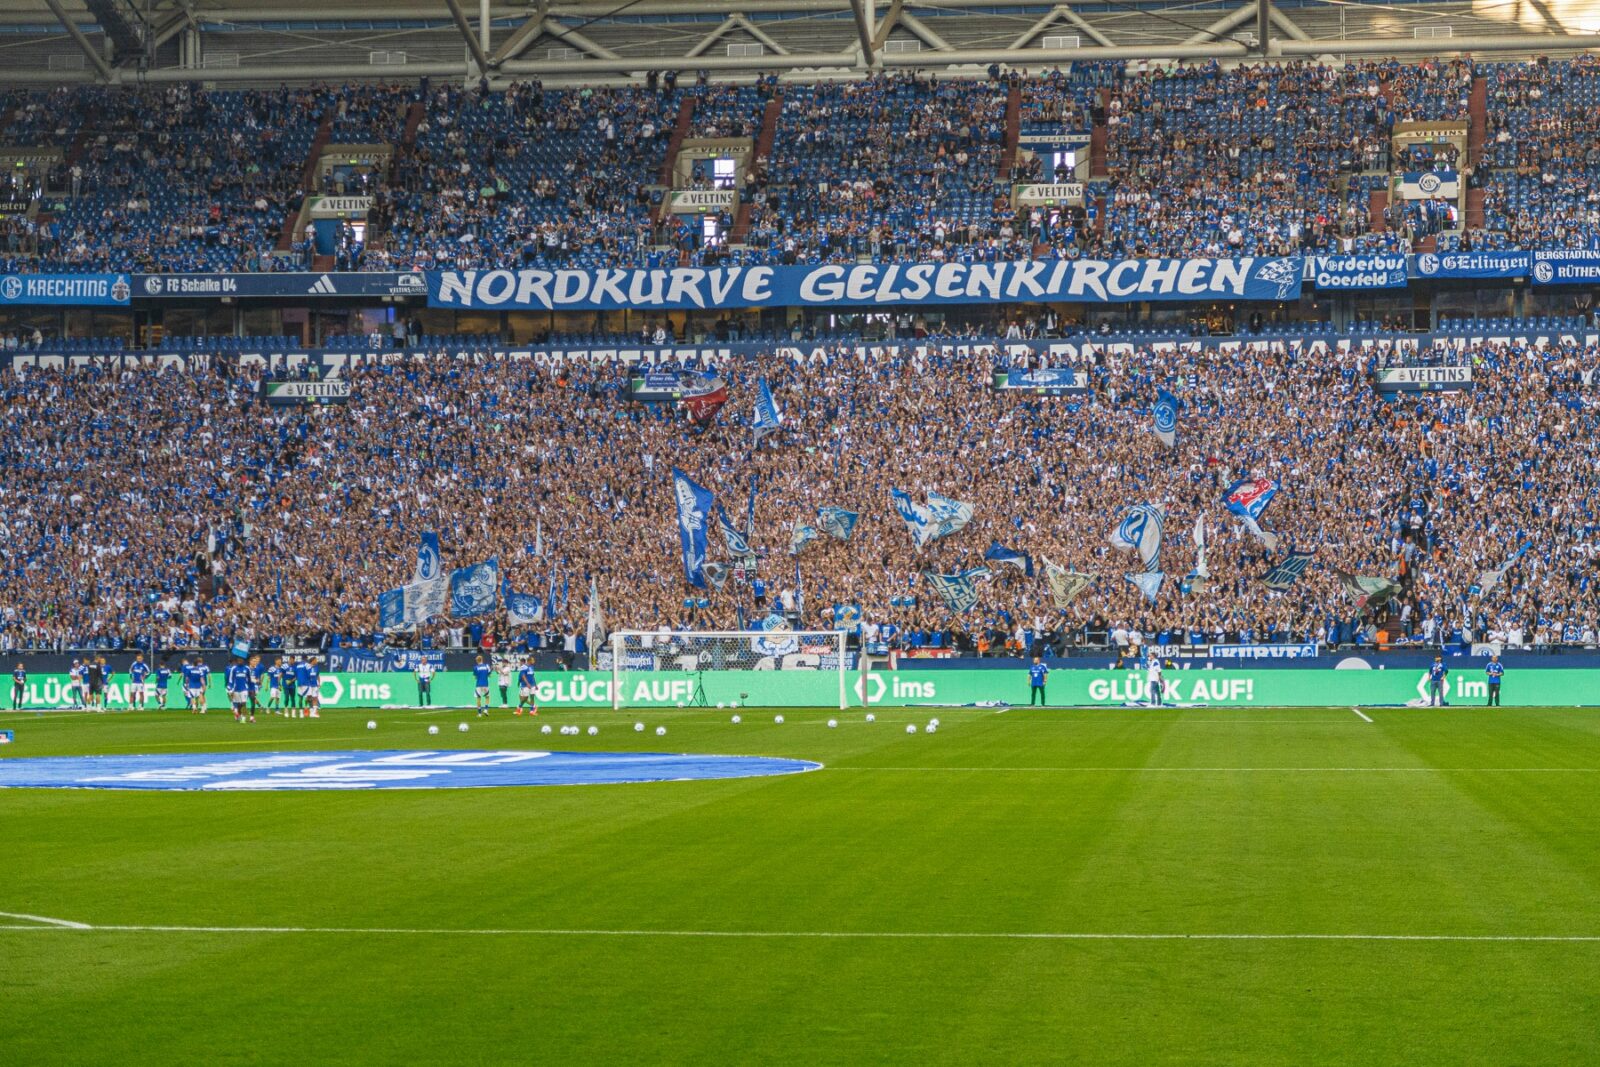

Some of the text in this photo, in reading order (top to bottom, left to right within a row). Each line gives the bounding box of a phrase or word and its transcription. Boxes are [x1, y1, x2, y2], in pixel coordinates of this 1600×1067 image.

[690, 193, 734, 203] VELTINS
[1037, 186, 1082, 197] VELTINS
[329, 199, 372, 209] VELTINS
[1535, 250, 1600, 260] BERGSTADTKN
[167, 278, 237, 292] FC Schalke 04
[438, 257, 1255, 310] NORDKURVE GELSENKIRCHEN
[1317, 271, 1388, 287] Coesfeld
[27, 279, 108, 297] KRECHTING
[1408, 368, 1466, 383] VELTINS
[296, 384, 348, 397] VELTINS
[350, 679, 391, 700] ims
[632, 679, 694, 702] AUF!
[892, 677, 936, 698] ims
[1190, 678, 1254, 701] AUF!
[1457, 675, 1488, 698] im
